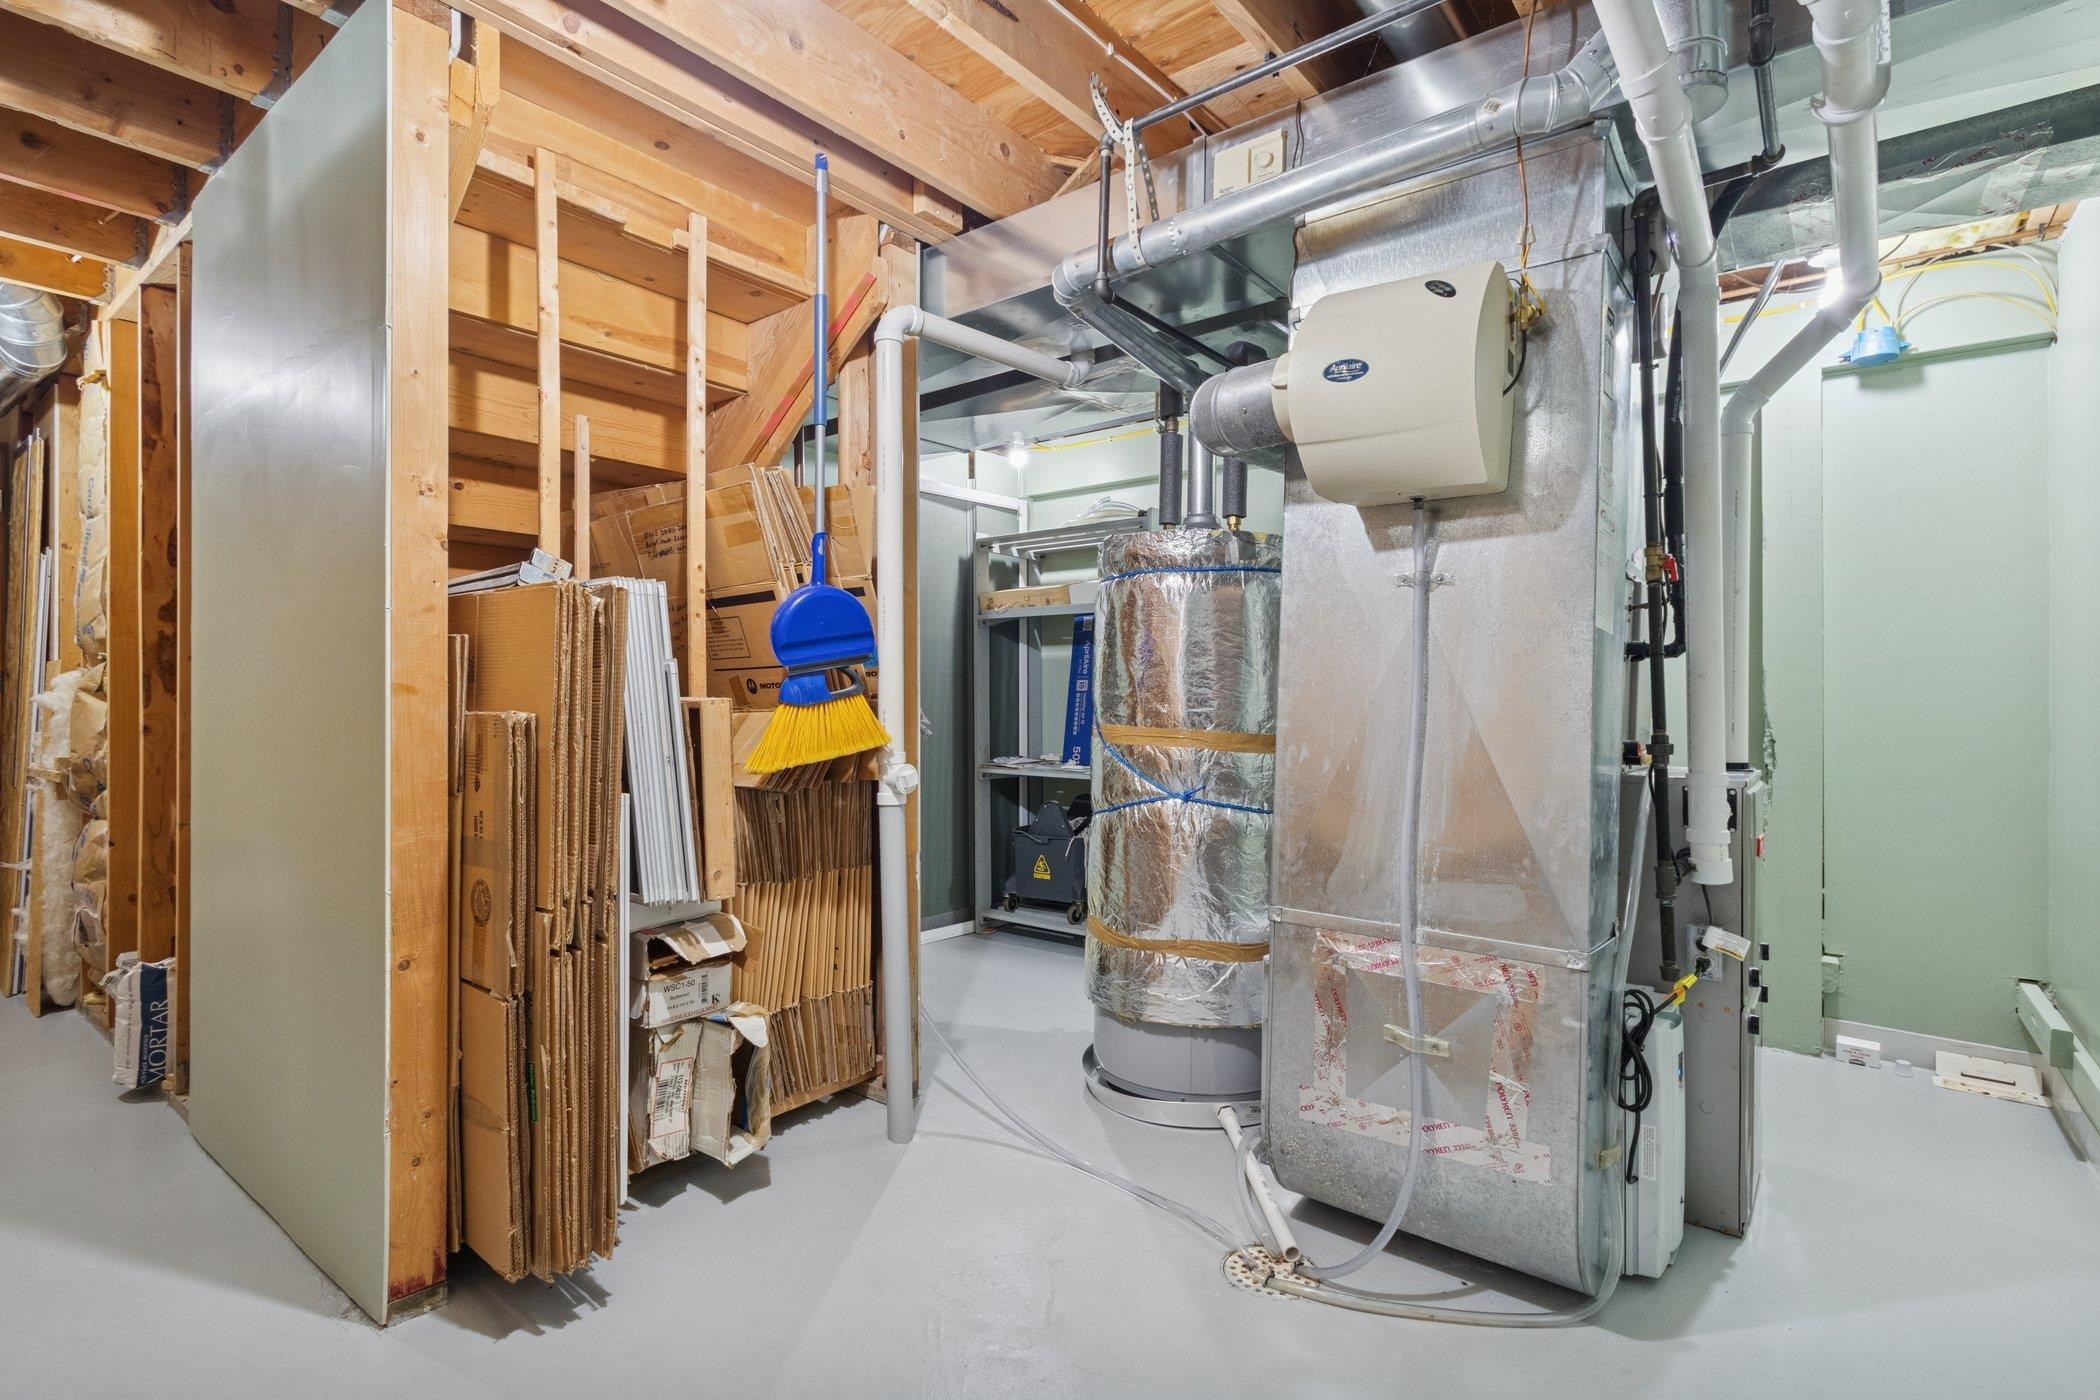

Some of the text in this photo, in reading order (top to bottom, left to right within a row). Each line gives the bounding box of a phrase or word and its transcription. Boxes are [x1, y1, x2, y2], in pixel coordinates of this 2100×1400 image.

[663, 979, 696, 993] WSC1-50
[662, 1011, 693, 1024] HARDWOOD
[148, 999, 168, 1084] MORTAR
[1496, 1082, 1513, 1119] POLYKEN
